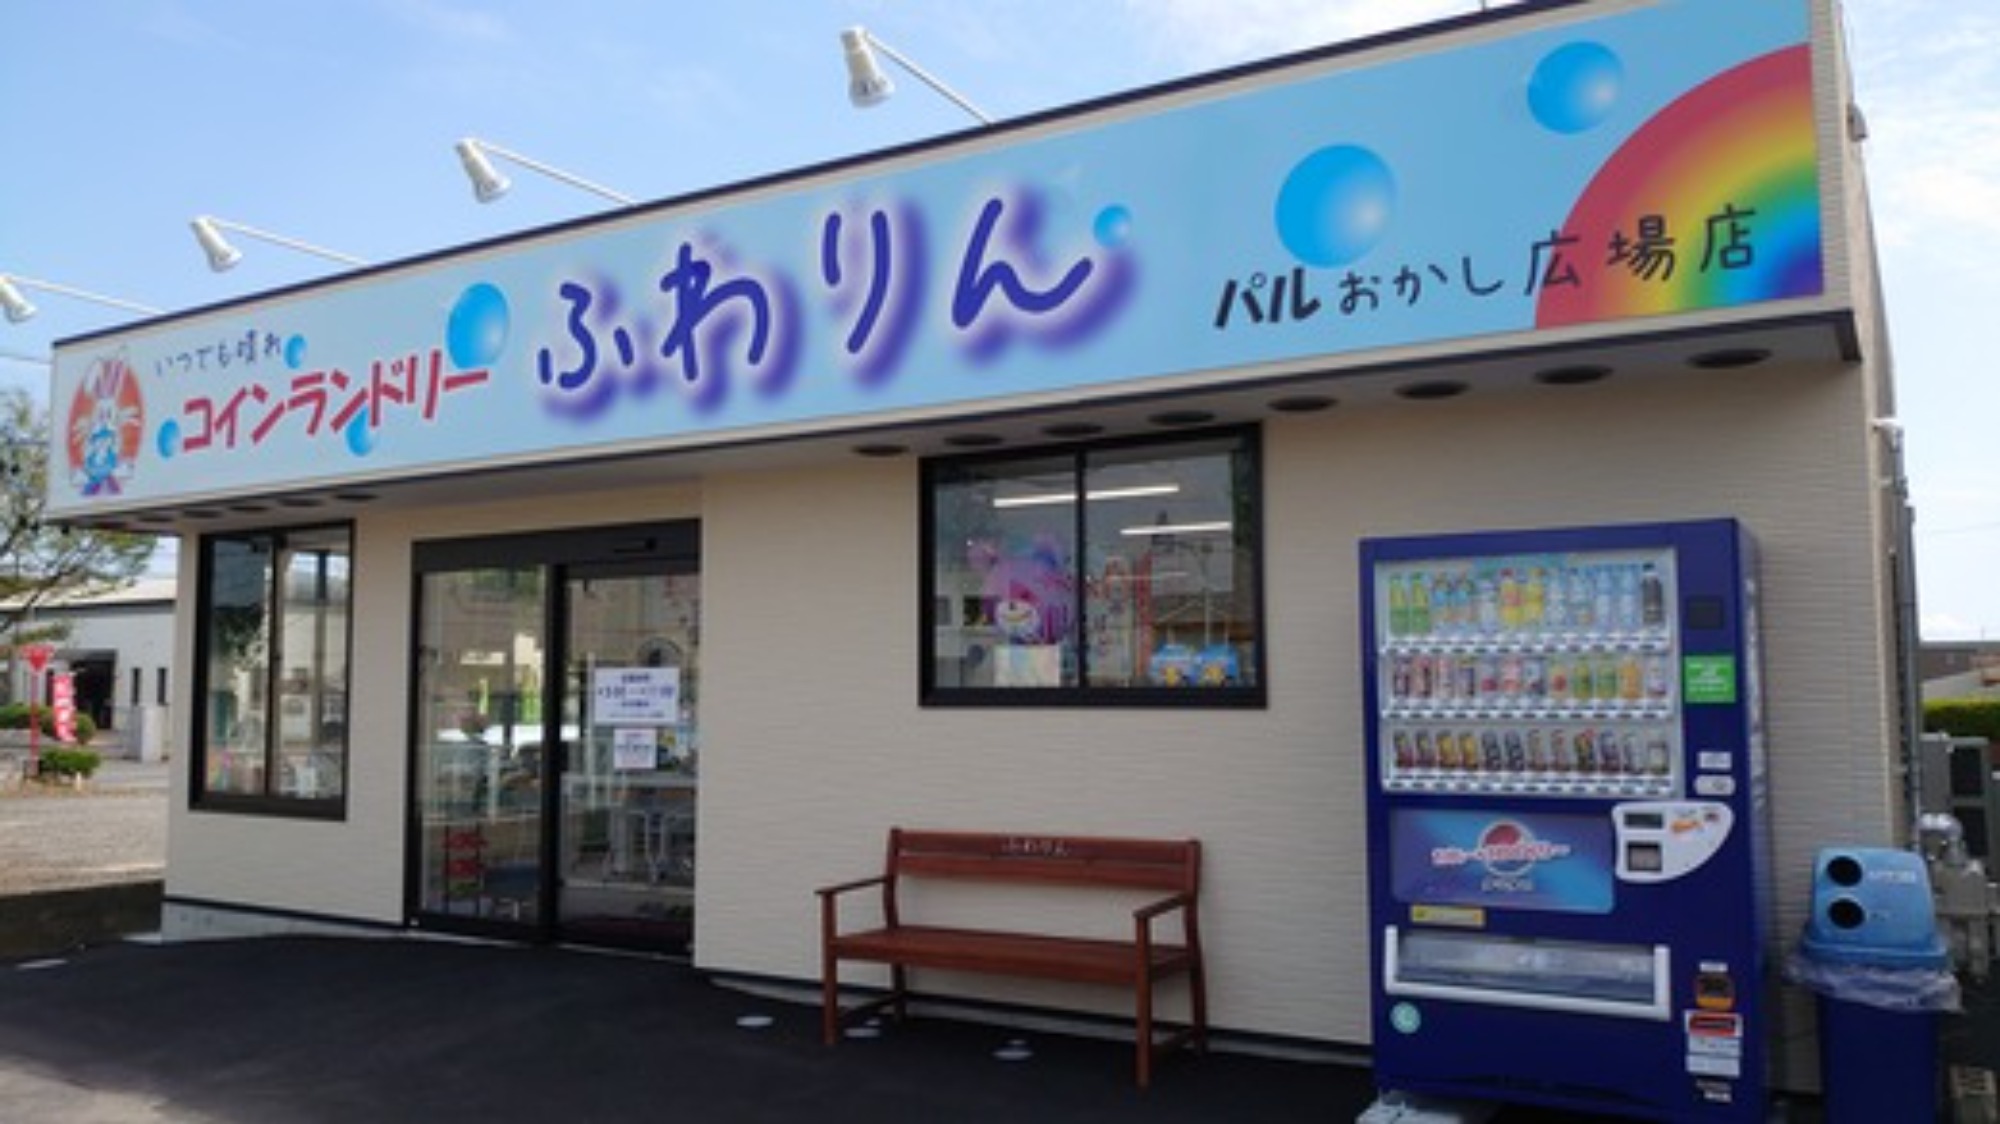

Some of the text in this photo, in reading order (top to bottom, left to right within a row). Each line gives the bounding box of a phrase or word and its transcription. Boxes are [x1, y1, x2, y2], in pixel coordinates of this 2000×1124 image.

[538, 197, 1094, 390] ふわりん
[1213, 203, 1758, 329] パルおかし広場店
[181, 348, 490, 454] コインランドリー
